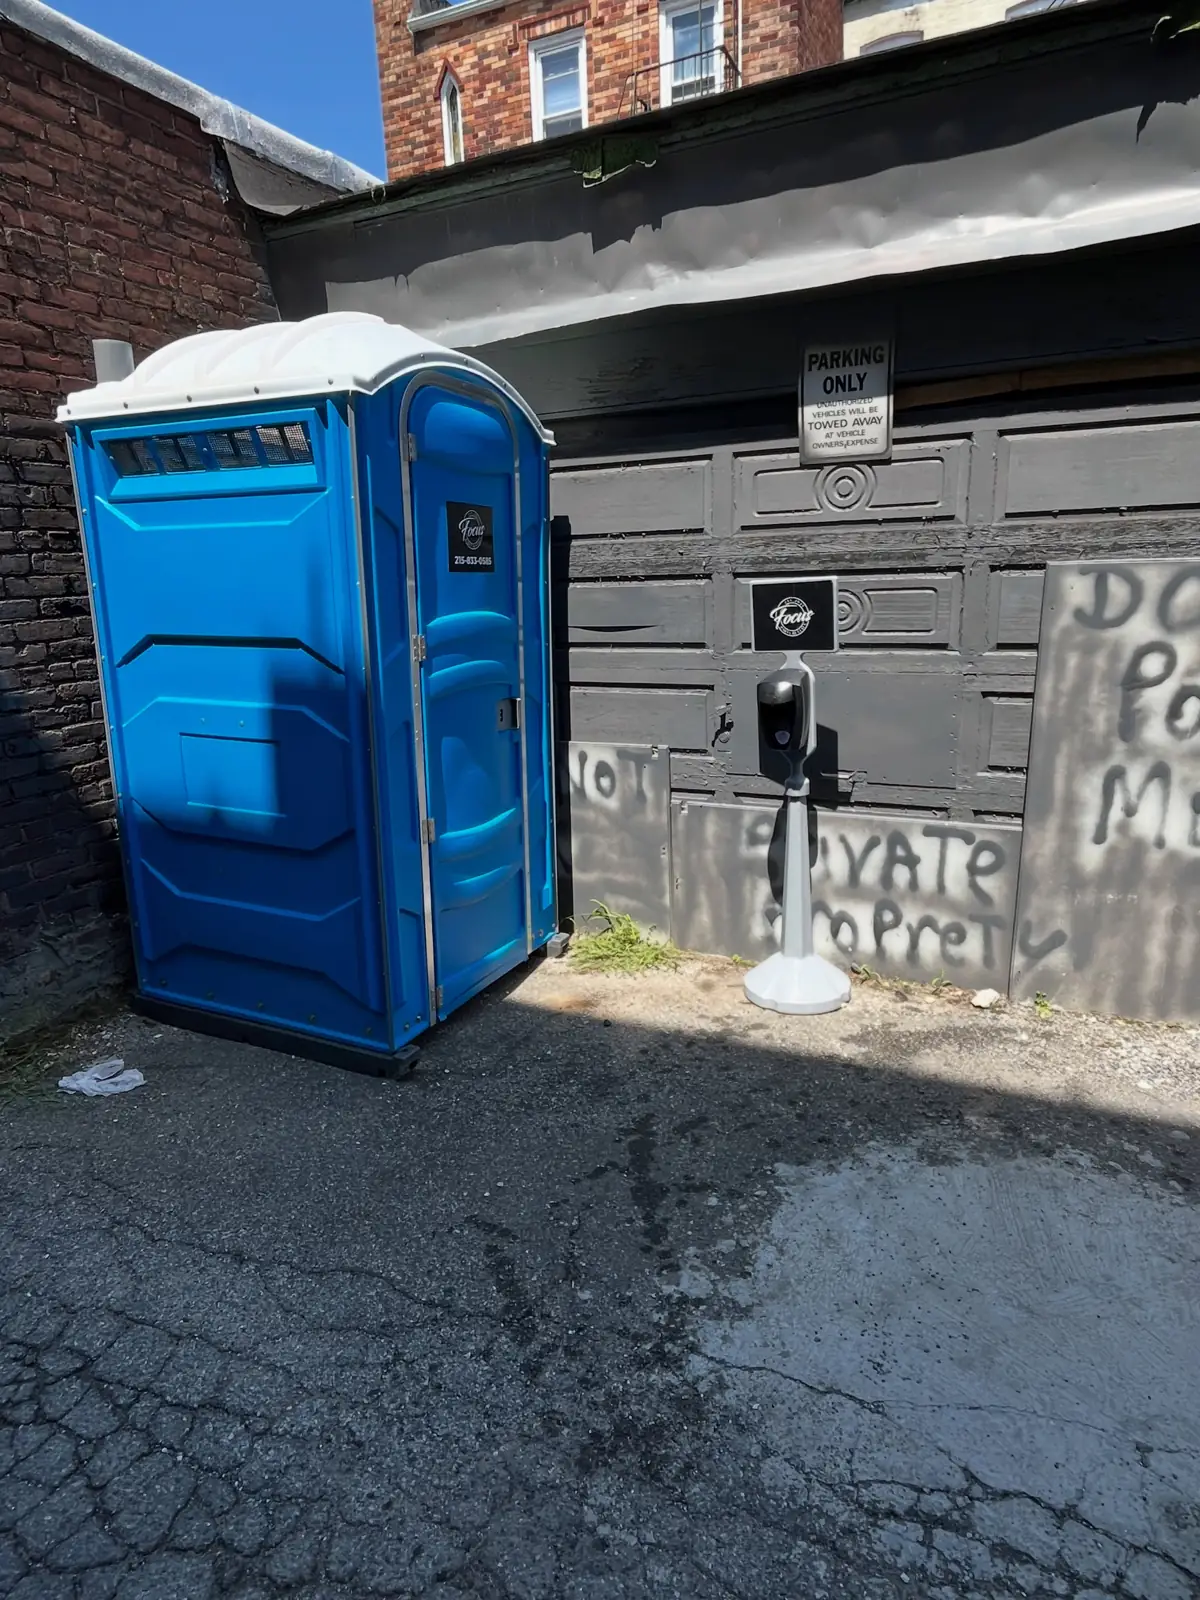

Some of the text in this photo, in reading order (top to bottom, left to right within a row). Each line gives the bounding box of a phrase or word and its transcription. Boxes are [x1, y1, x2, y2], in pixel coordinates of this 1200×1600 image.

[807, 345, 885, 372] PARKING
[823, 372, 867, 395] ONLY
[816, 397, 873, 408] UNAUTHORIZED
[812, 409, 846, 418] VEHICLES
[848, 407, 865, 415] WILL
[808, 416, 883, 430] TOWED AWAY
[825, 429, 866, 439] AT VEHICLE
[846, 437, 879, 446] EXPENSE
[458, 517, 485, 542] Focus
[769, 604, 815, 630] Focus
